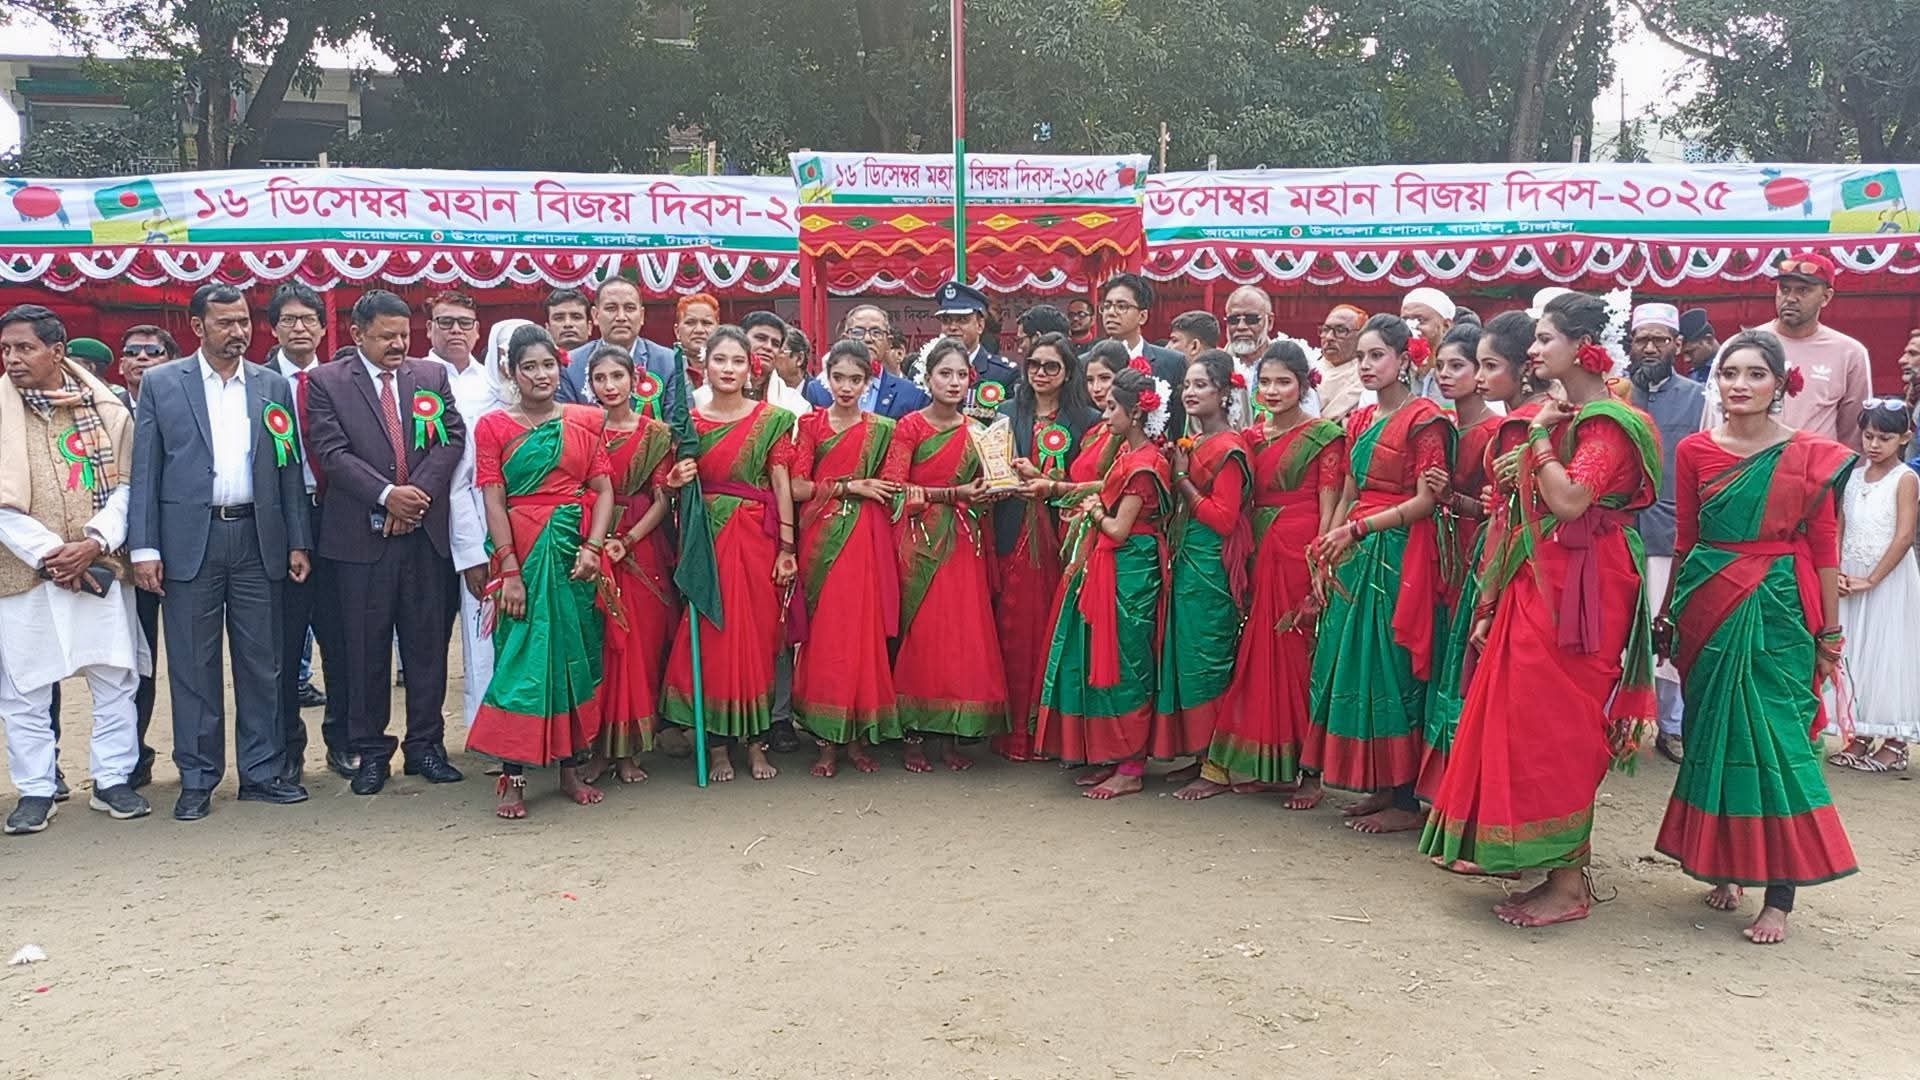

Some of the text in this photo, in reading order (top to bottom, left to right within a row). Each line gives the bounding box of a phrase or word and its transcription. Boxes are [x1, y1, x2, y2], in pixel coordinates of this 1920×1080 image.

[834, 156, 1107, 194] ১৬ ডিসেম্বর মহা বিজয় দিবস-২০২৫
[1286, 181, 1380, 216] মহান
[1392, 171, 1494, 214] বিজয়
[1505, 169, 1733, 214] দিবস-২০২৫
[194, 187, 249, 219] ১৬
[265, 176, 410, 219] ডিসেম্বর
[421, 185, 519, 222] মহান
[532, 179, 637, 224] বিজয়
